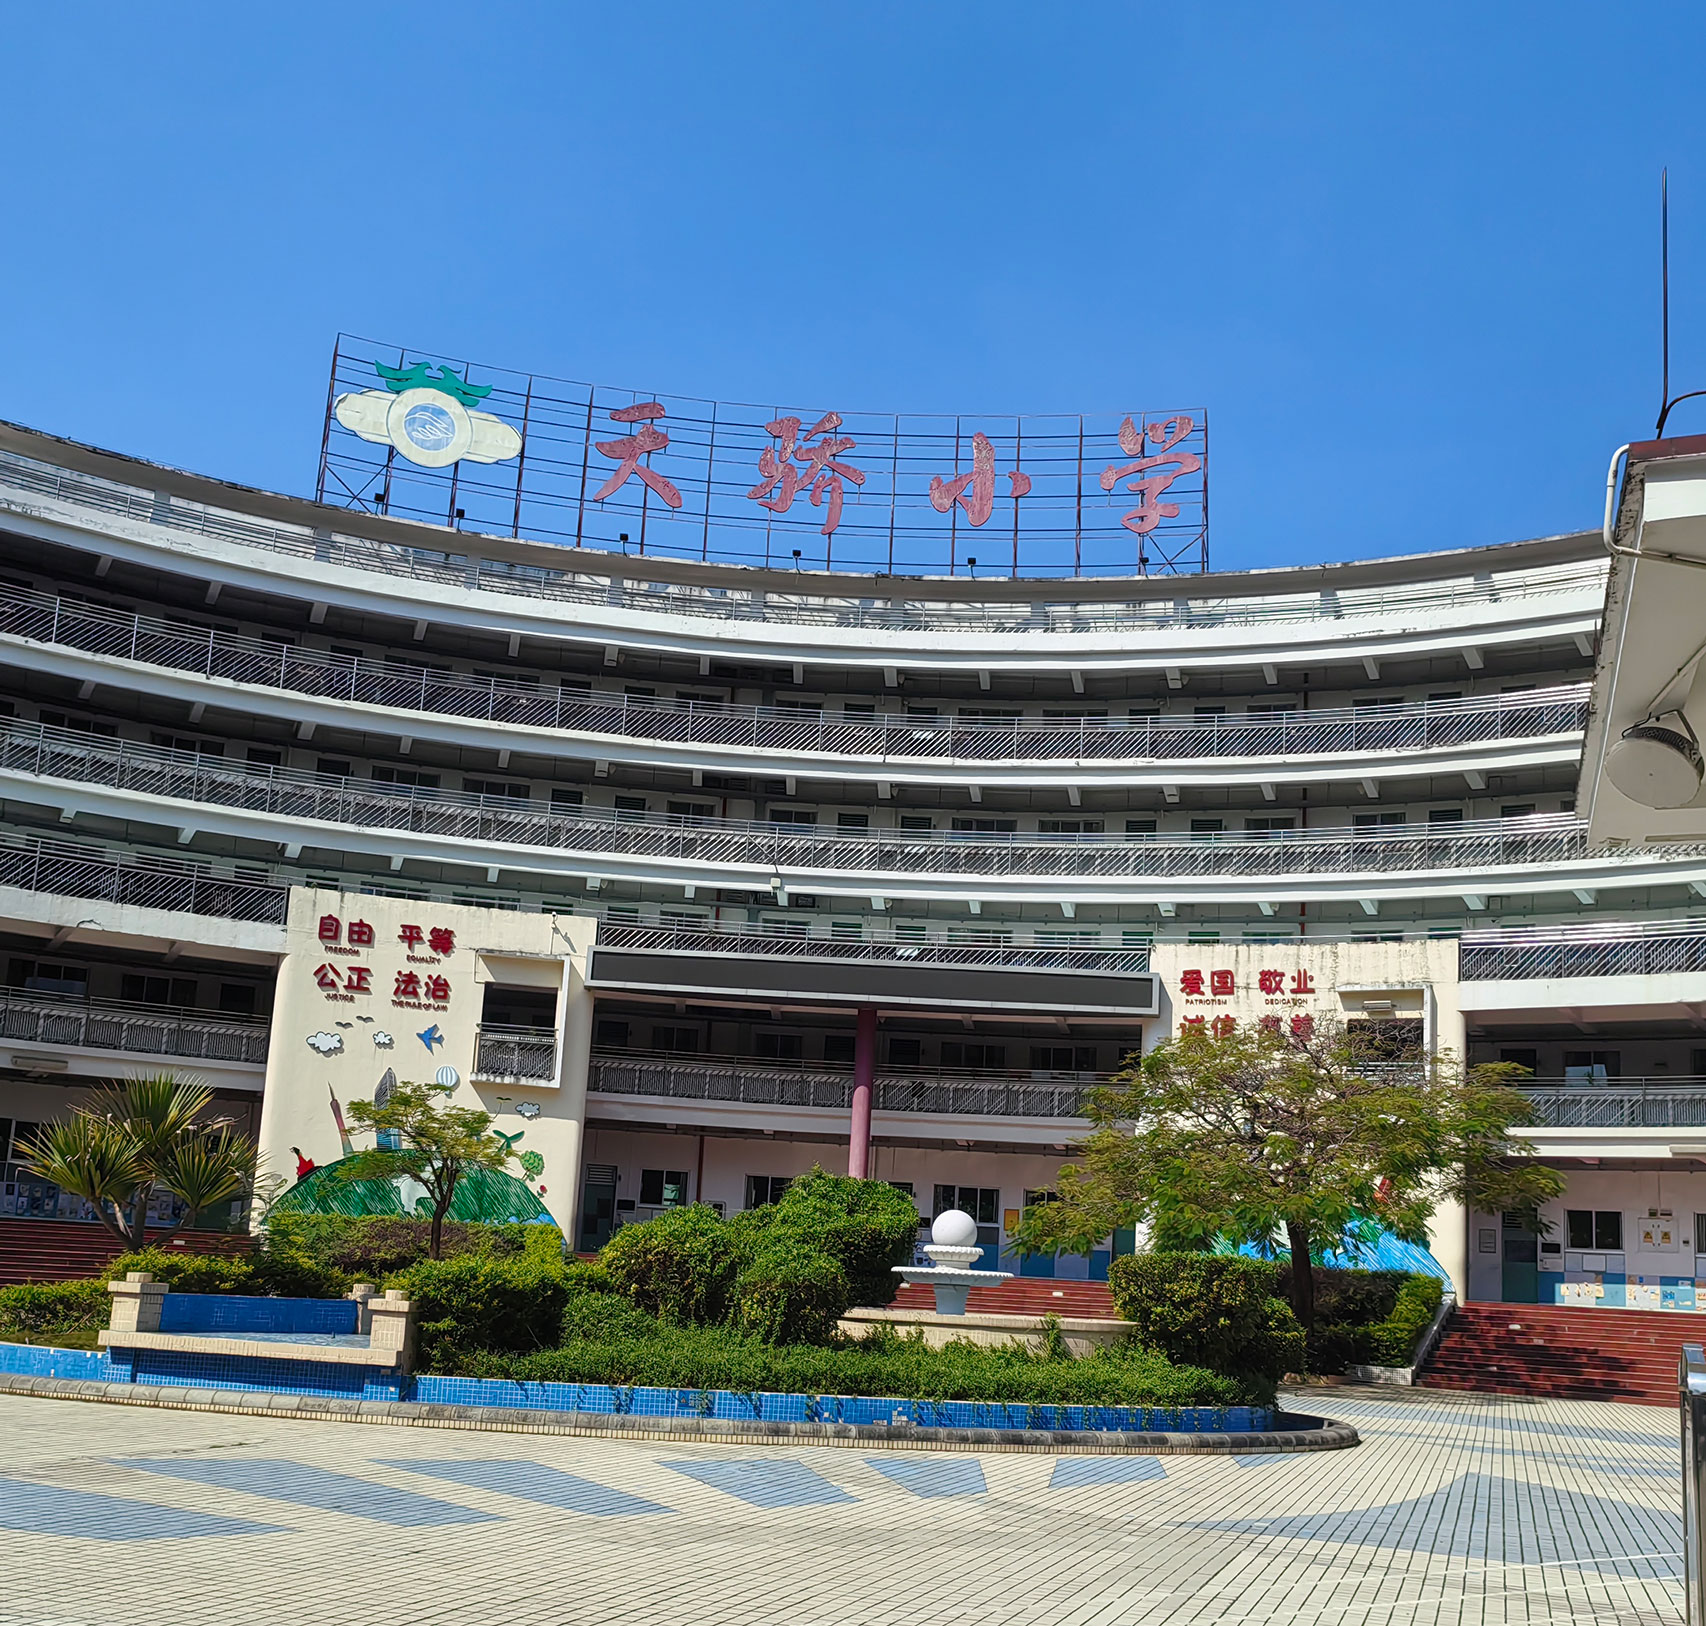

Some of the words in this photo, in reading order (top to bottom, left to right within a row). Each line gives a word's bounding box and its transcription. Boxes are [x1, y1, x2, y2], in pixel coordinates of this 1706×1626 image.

[593, 402, 1201, 535] 天骄小学
[318, 914, 375, 948] 自由
[398, 924, 456, 958] 平等
[324, 945, 360, 957] FREEDOM
[406, 953, 442, 965] EQUALITY
[313, 962, 374, 995] 公正
[393, 970, 452, 1003] 法治
[1179, 969, 1235, 996] 爱国
[1257, 968, 1316, 996] 敬业
[324, 992, 356, 1003] JUSTICE
[1185, 998, 1228, 1006] PATRIOTISM
[1265, 998, 1309, 1006] DEDICATION
